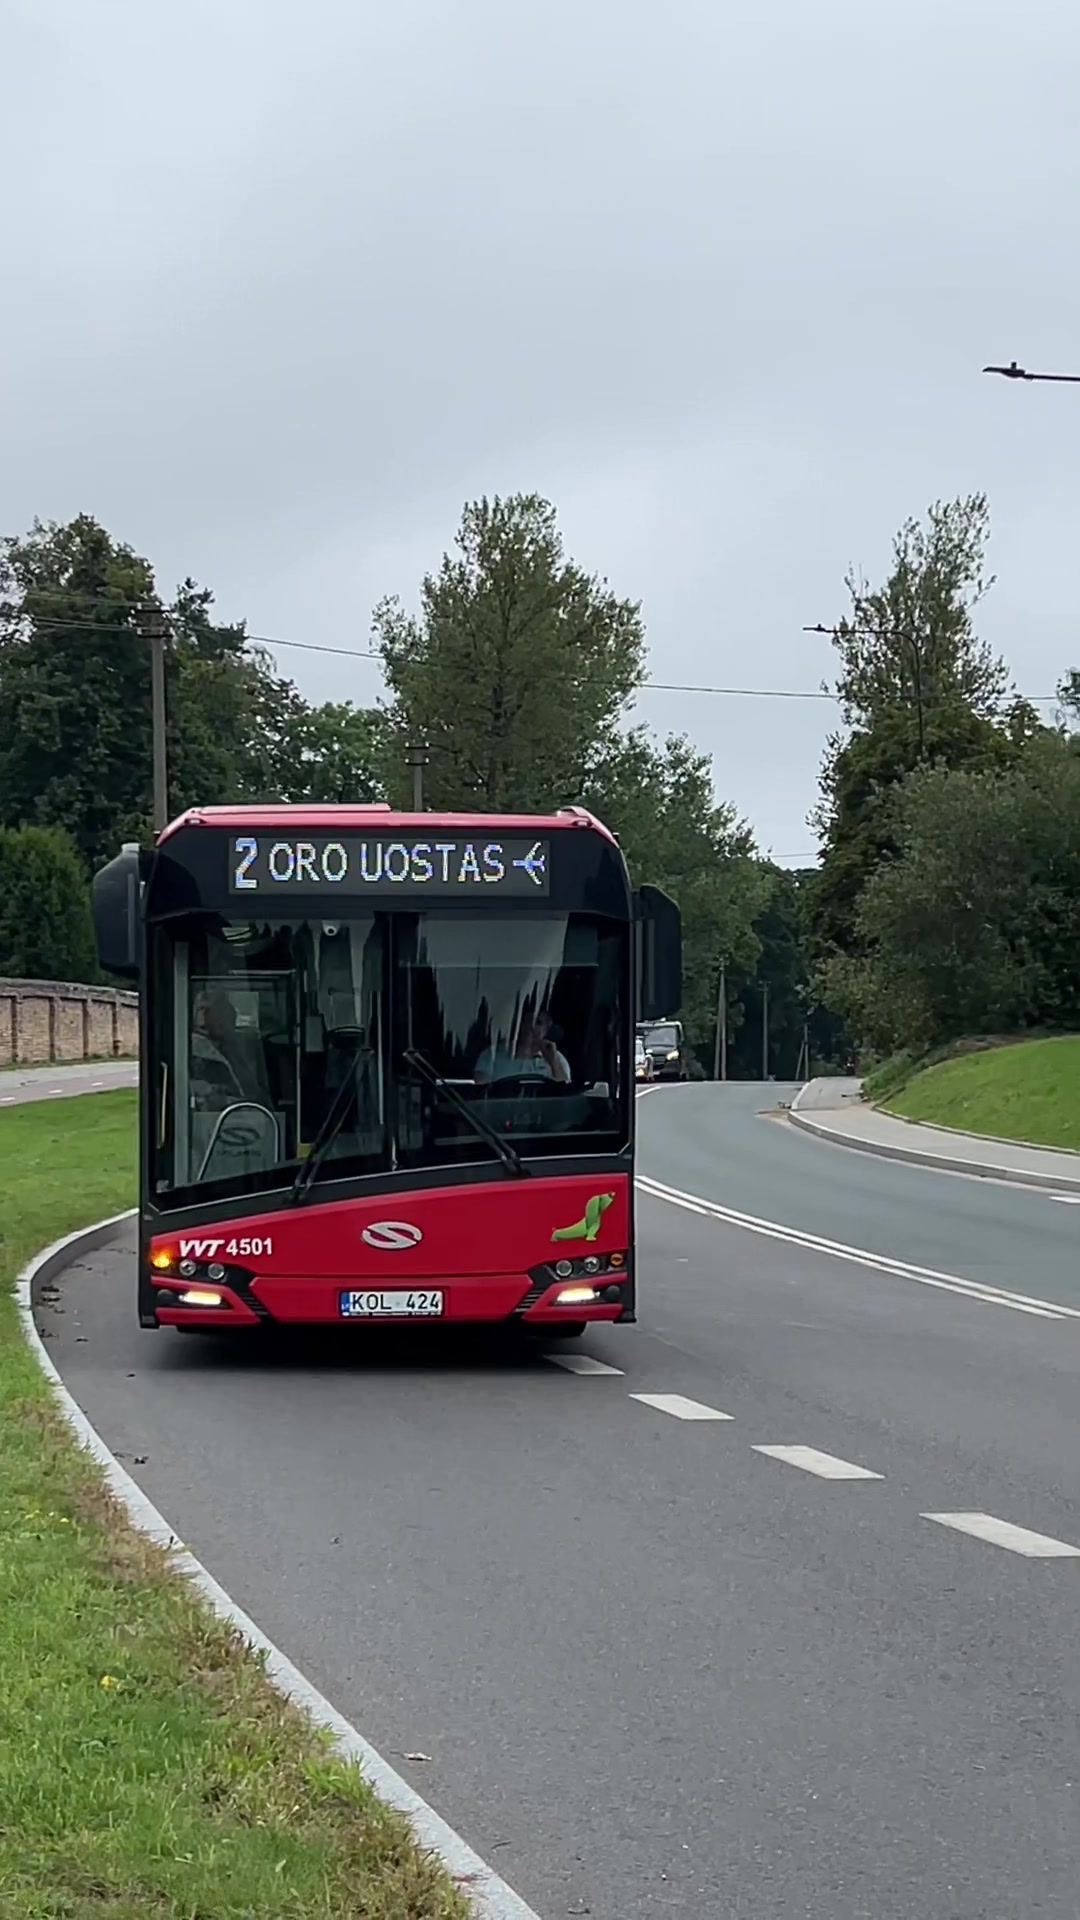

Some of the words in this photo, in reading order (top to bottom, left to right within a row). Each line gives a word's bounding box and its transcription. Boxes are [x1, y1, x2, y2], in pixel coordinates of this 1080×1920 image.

[235, 838, 258, 889] 2
[269, 843, 348, 882] ORO
[360, 843, 506, 882] UOSTAS
[225, 1237, 273, 1257] 4501
[351, 1293, 393, 1311] KOL
[406, 1293, 440, 1310] 424
